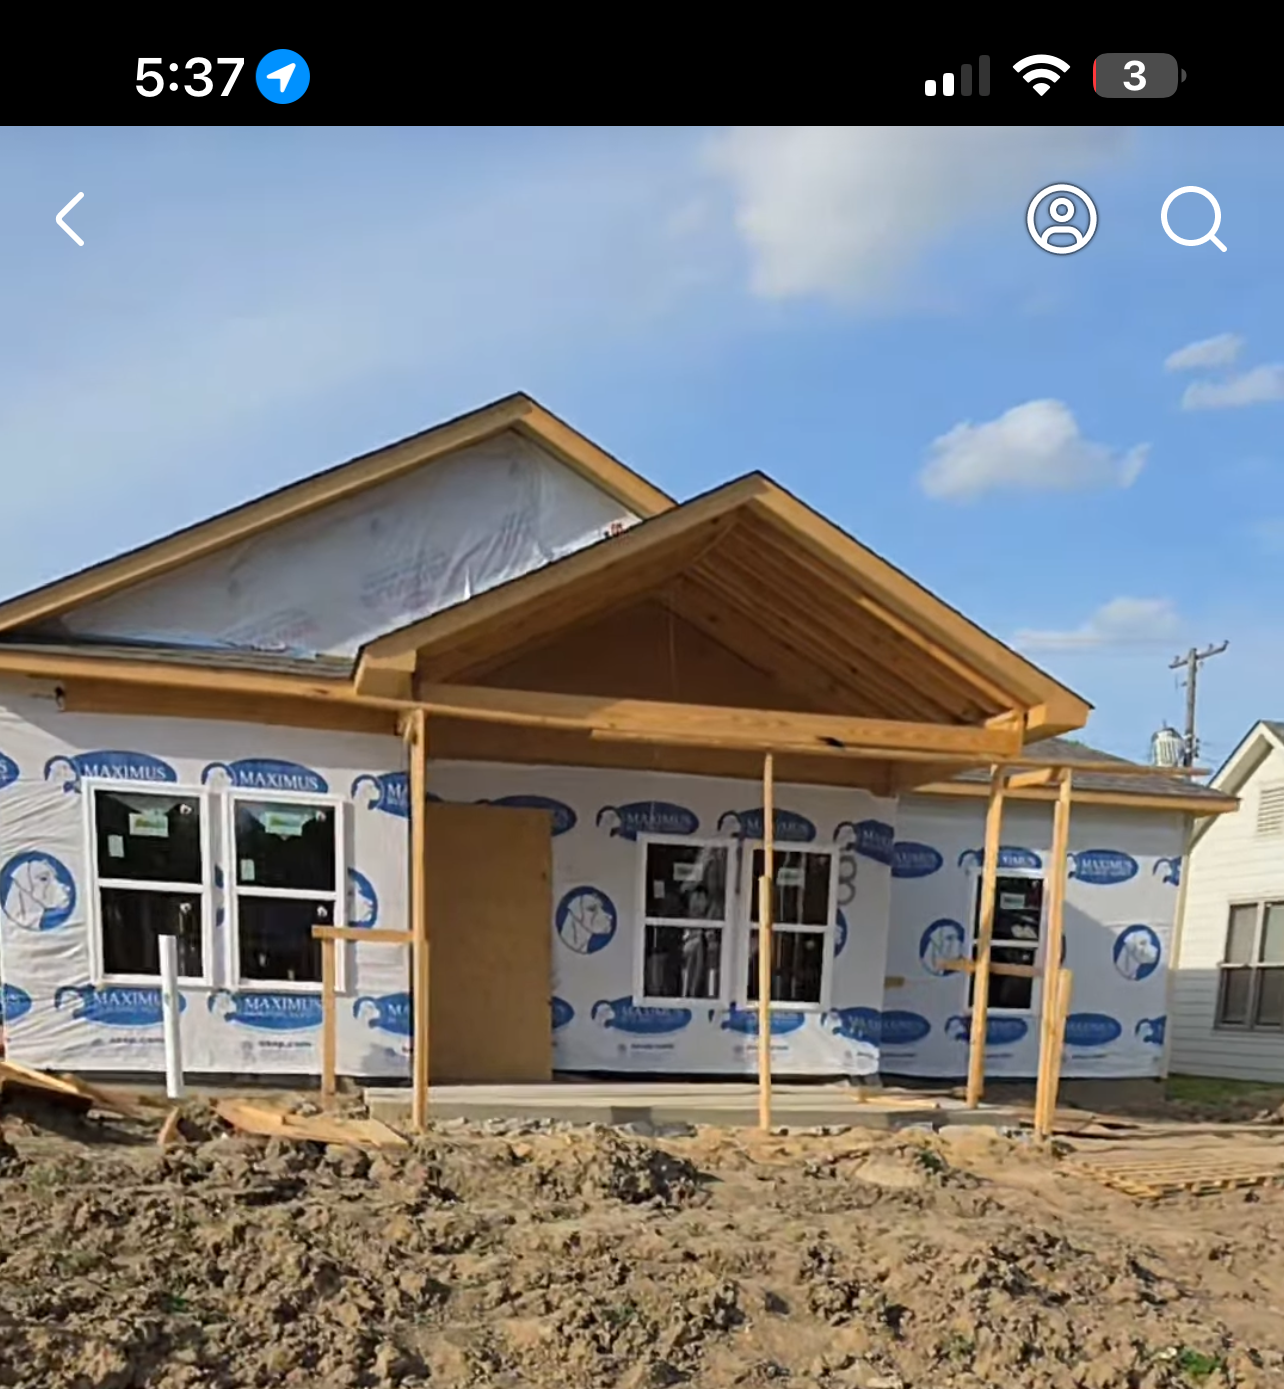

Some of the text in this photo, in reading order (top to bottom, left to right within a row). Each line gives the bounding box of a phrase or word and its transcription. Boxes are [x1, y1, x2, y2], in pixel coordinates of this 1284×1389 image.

[84, 764, 167, 782] MAXIMUS
[240, 771, 319, 791] MAXIMUS
[93, 991, 163, 1008] MAXIMU
